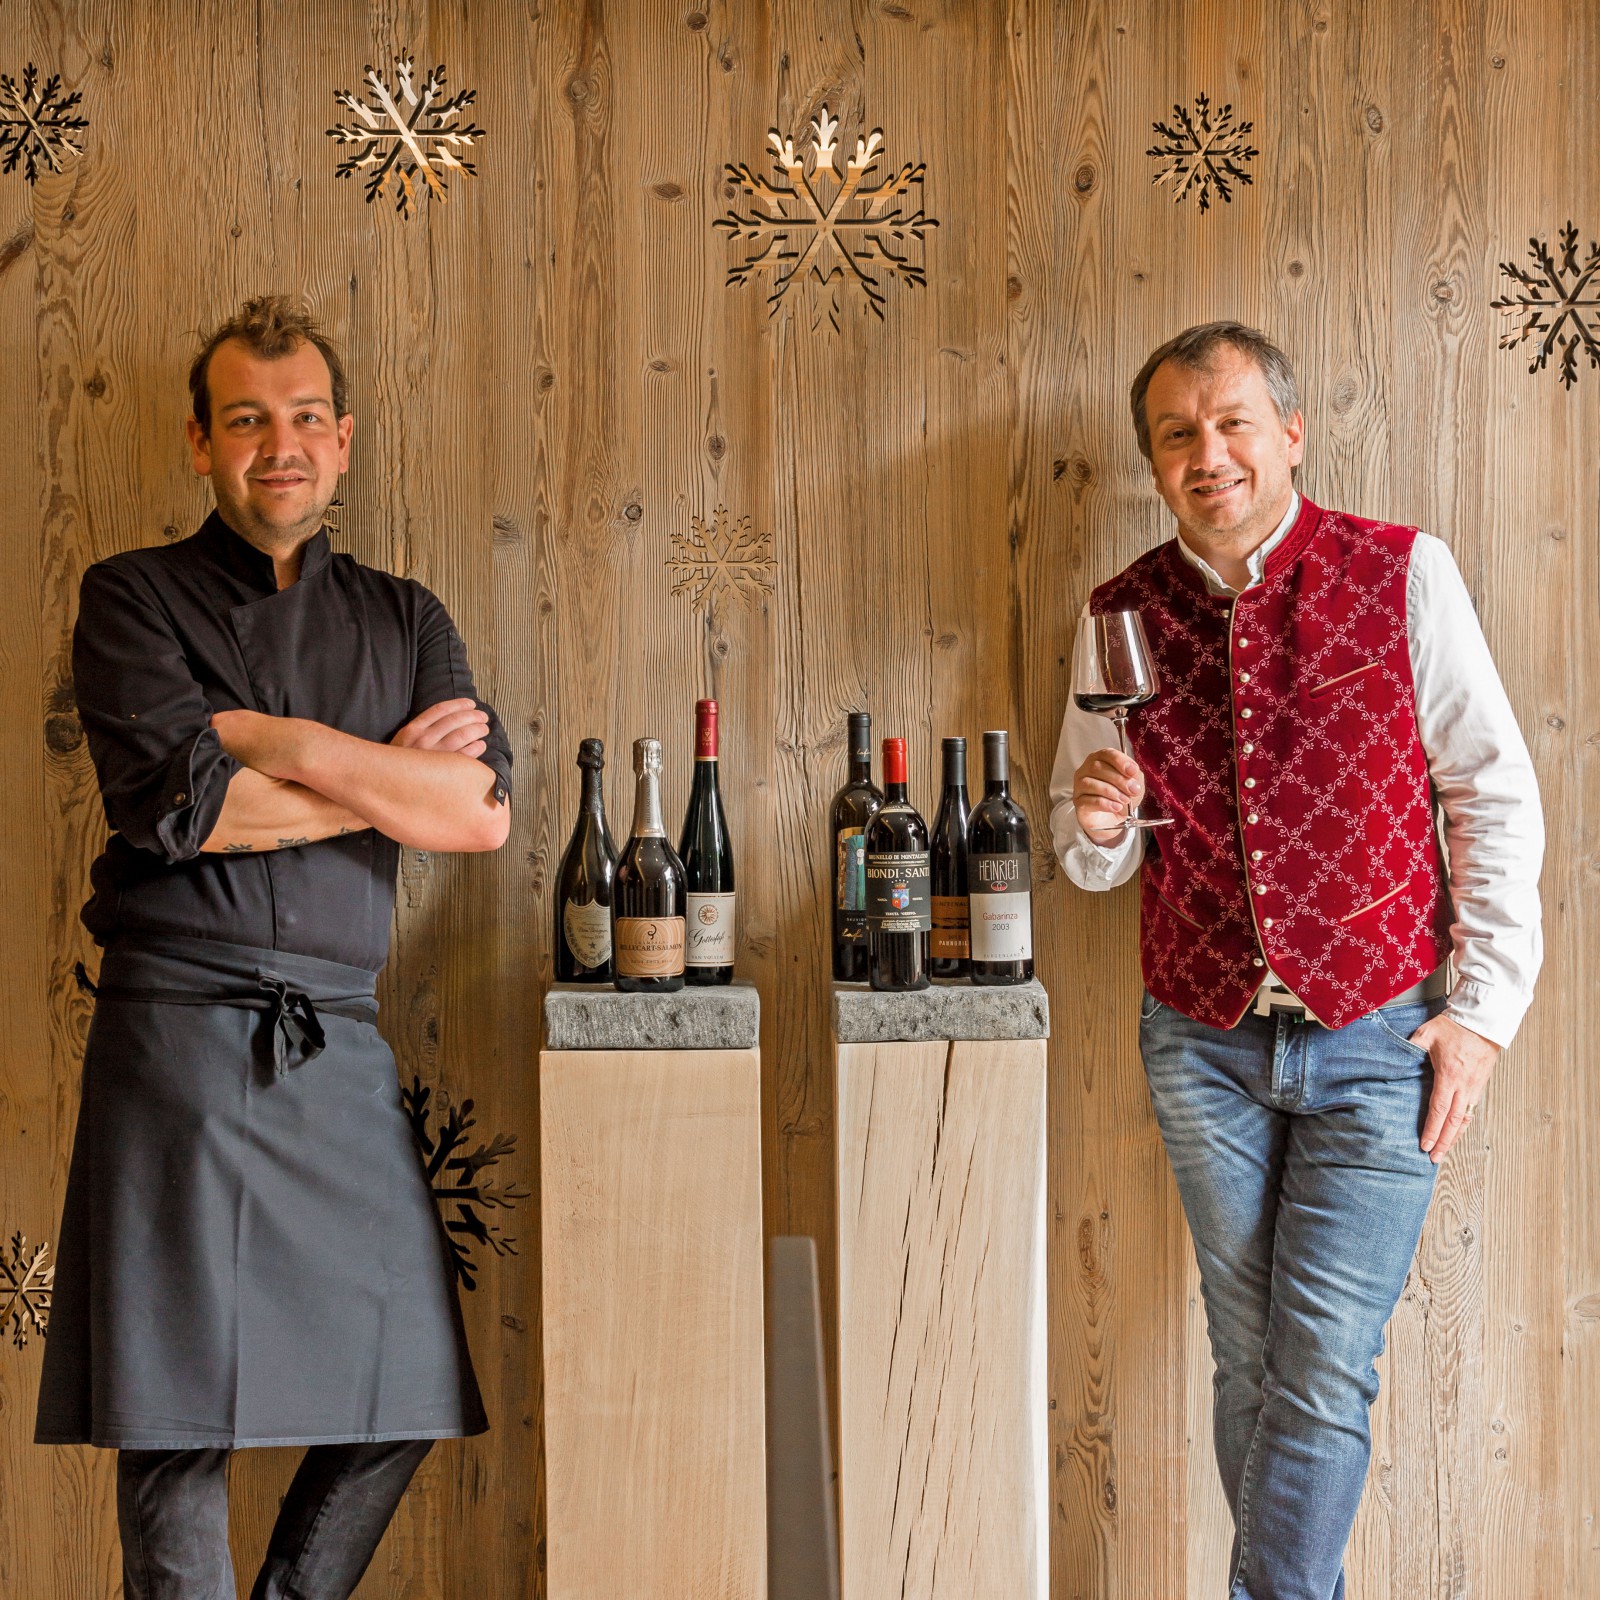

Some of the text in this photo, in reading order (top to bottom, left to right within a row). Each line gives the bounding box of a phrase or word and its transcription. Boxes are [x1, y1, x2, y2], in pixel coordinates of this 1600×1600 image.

[978, 859, 1019, 881] HEINRICH
[982, 912, 1018, 921] Gabarinza
[992, 923, 1010, 931] 2003
